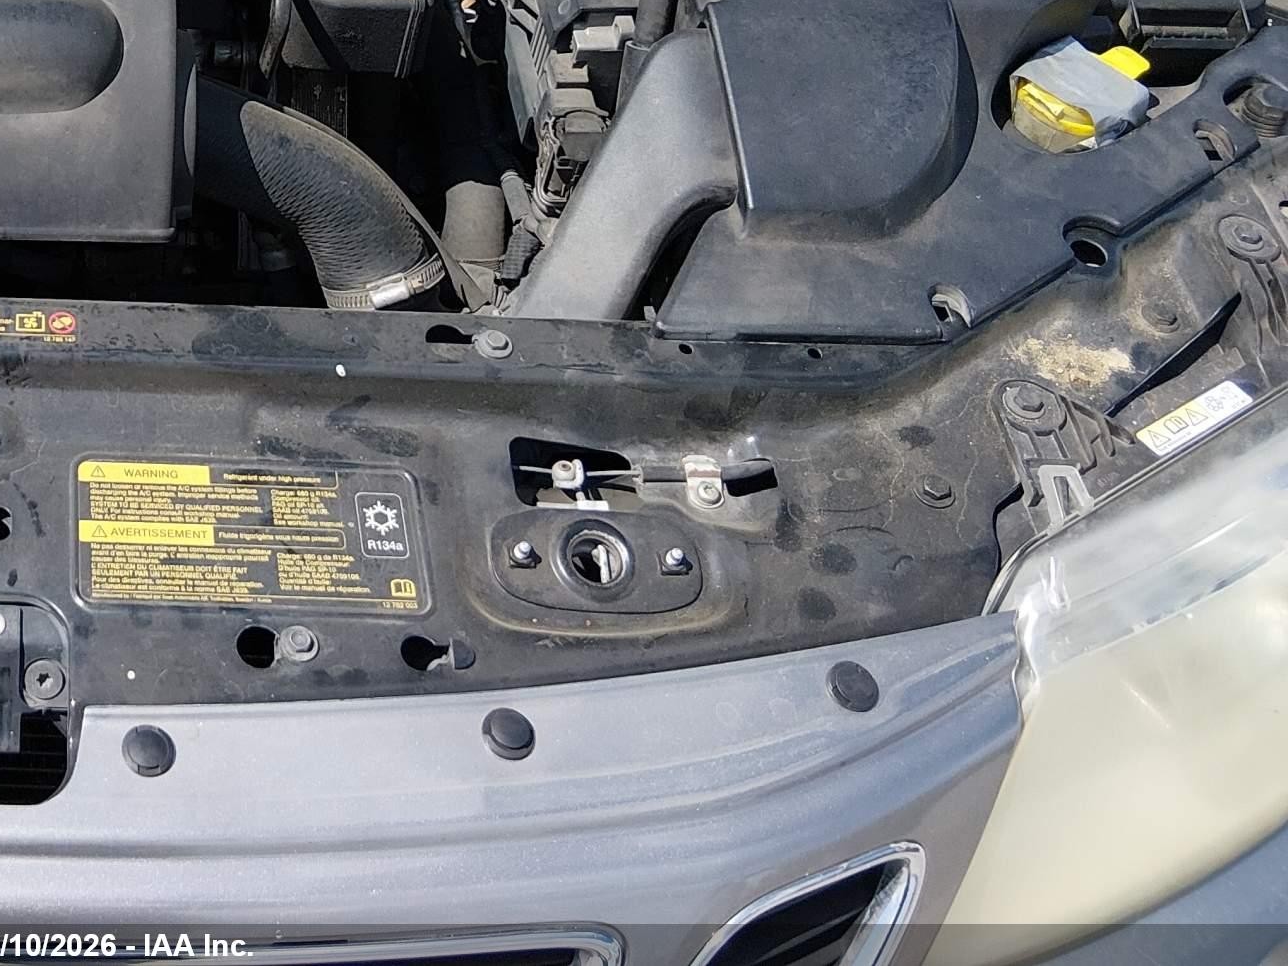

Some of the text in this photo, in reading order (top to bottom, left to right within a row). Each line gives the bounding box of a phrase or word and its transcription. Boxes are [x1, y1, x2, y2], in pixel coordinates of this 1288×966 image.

[124, 468, 178, 478] WARNING
[111, 528, 207, 539] AVERTISSEMENT
[367, 540, 403, 550] R134a
